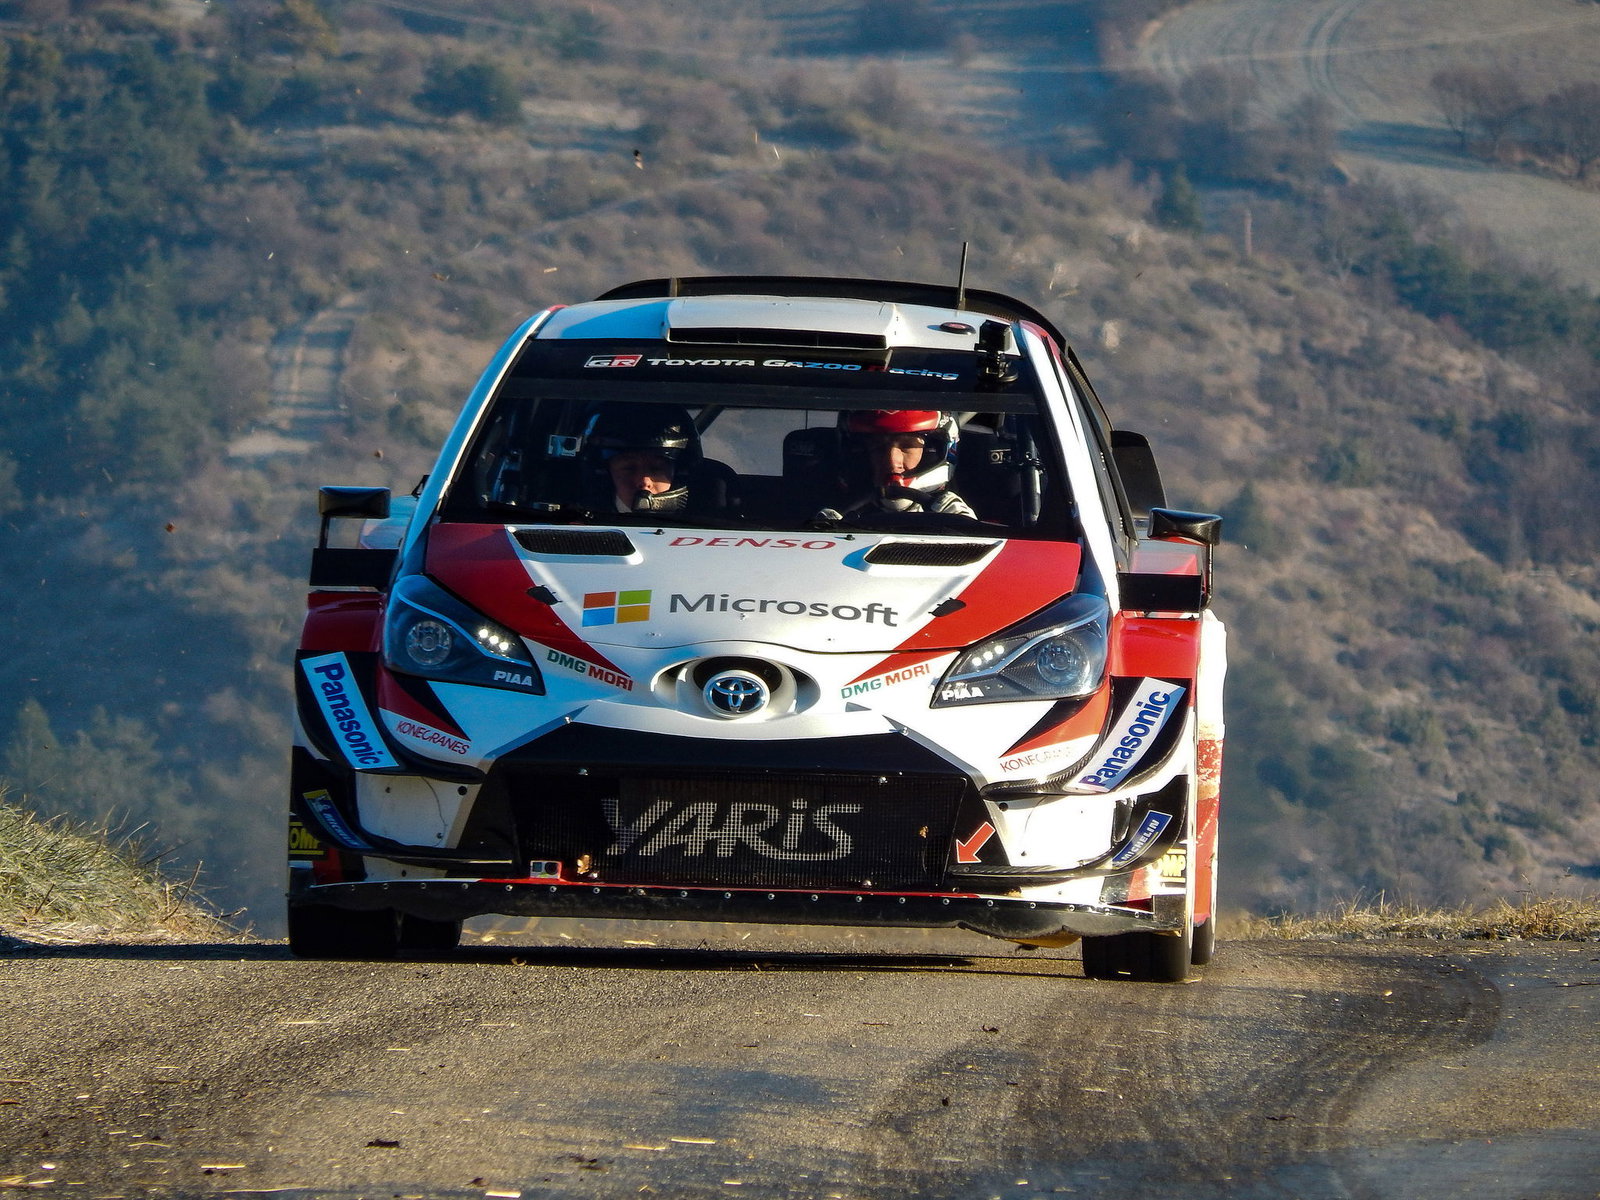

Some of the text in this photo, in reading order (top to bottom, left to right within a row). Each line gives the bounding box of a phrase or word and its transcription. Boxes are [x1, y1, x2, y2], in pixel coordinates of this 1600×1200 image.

[646, 358, 756, 367] TOYOTA
[668, 537, 836, 550] DENSO
[669, 593, 898, 627] Microsoft
[493, 670, 533, 687] PIAA
[547, 649, 634, 692] DMG MORI
[841, 663, 931, 699] DMG MORI
[942, 686, 985, 701] PIAA
[314, 662, 381, 765] Panasonic
[397, 720, 470, 755] KONECRANES
[1079, 690, 1171, 787] Panasonic
[1121, 819, 1160, 861] MICHELIN
